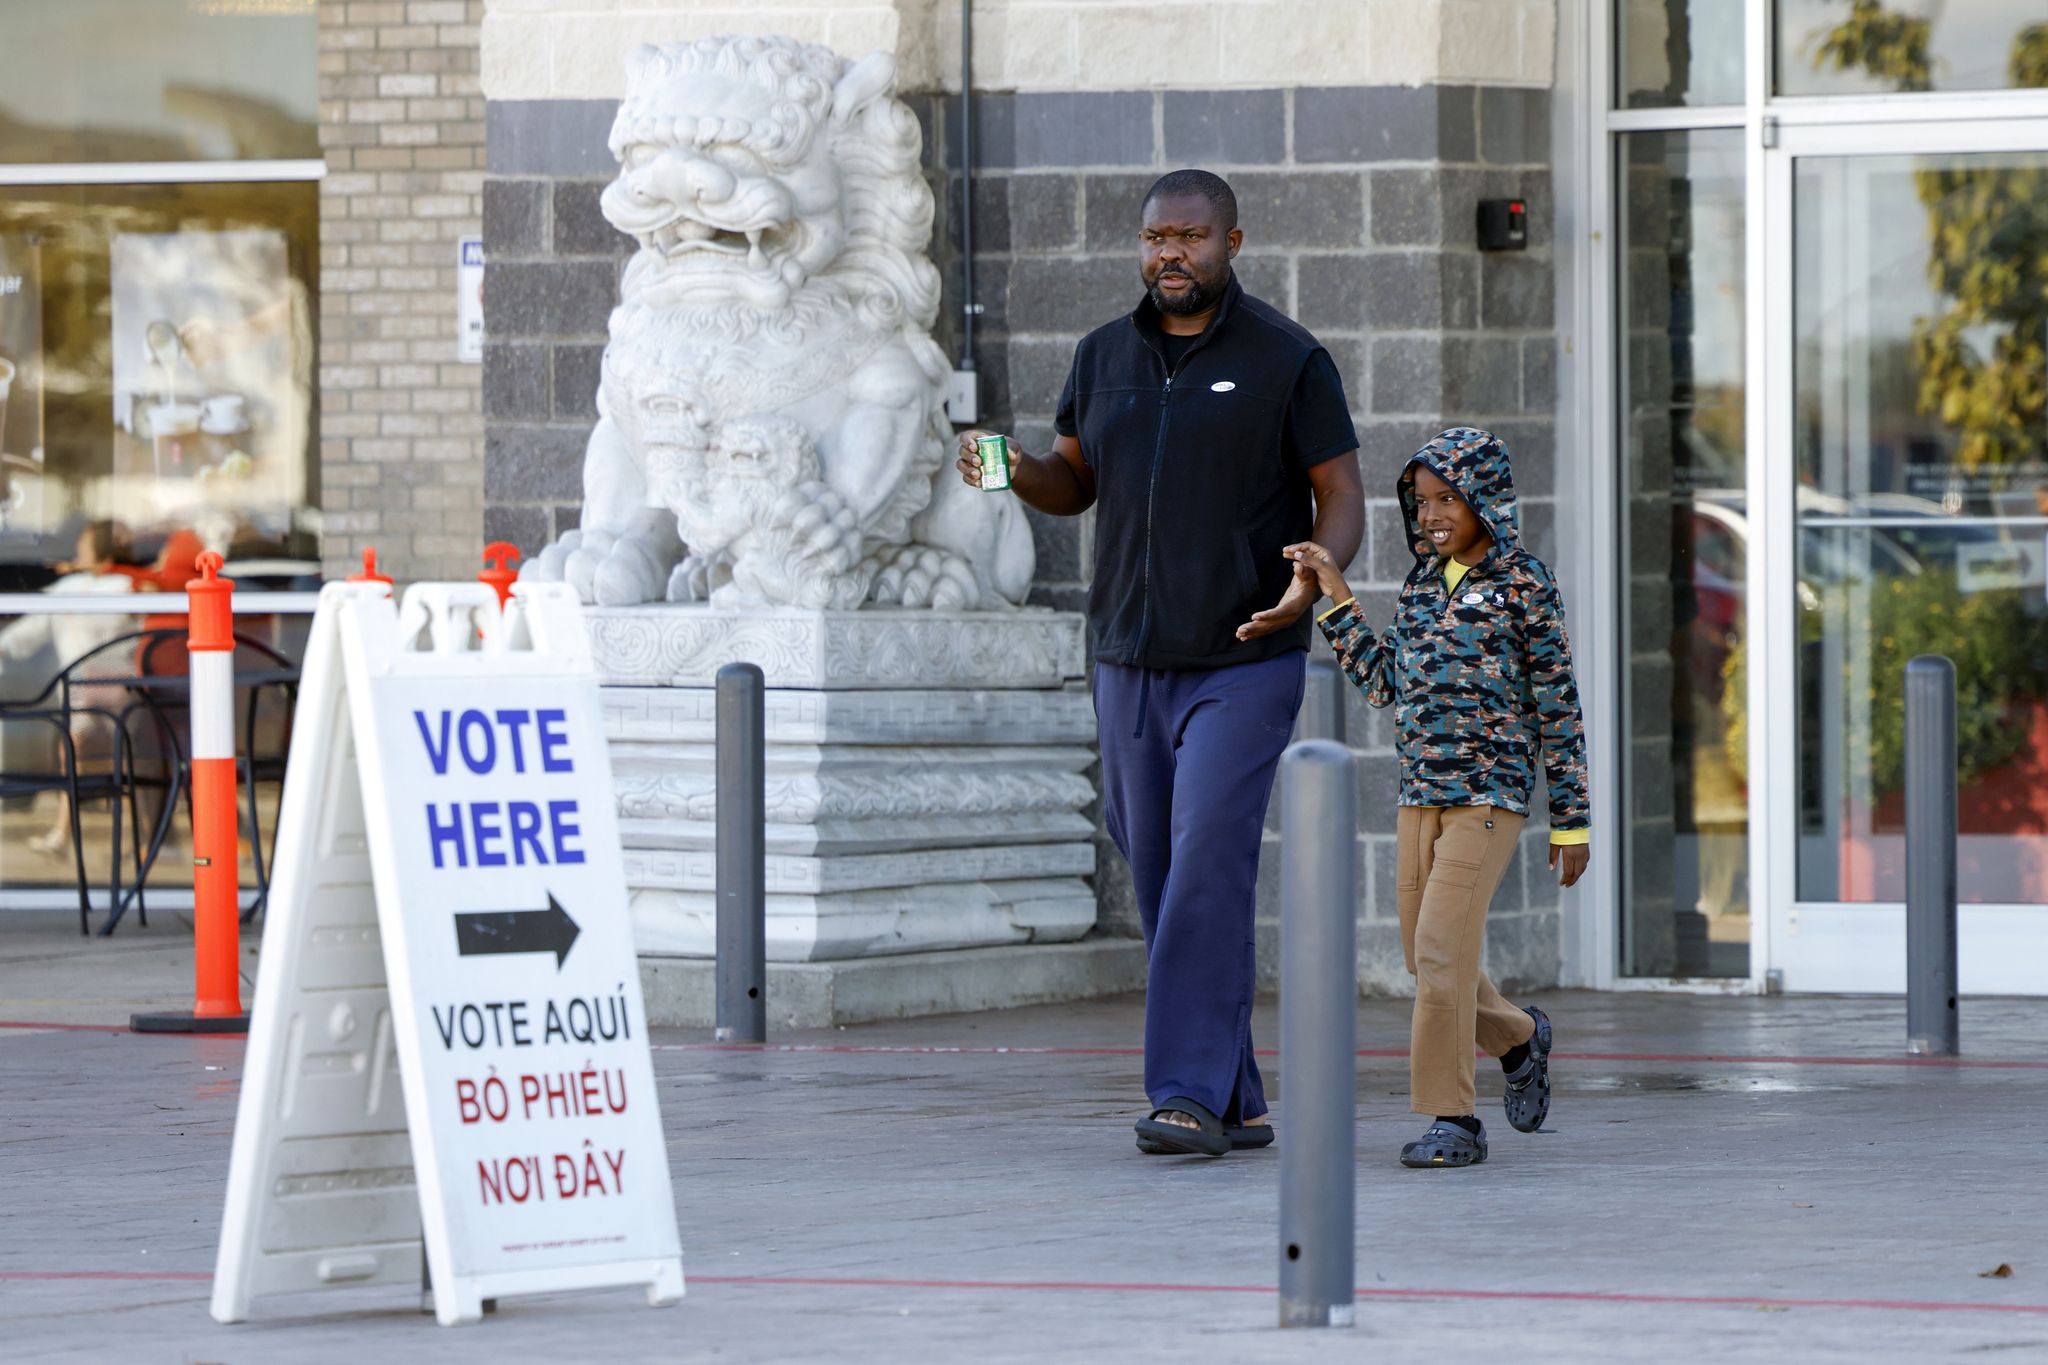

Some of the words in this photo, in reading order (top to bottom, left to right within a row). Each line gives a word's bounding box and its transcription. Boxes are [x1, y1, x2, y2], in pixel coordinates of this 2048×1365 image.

[413, 709, 575, 775] VOTE
[426, 800, 586, 869] HERE
[432, 1001, 533, 1050] VOTE
[543, 982, 631, 1045] AQUÍ
[520, 1058, 628, 1120] PHIẾU
[477, 1155, 545, 1206] NƠI
[554, 1138, 625, 1200] ĐÂY
